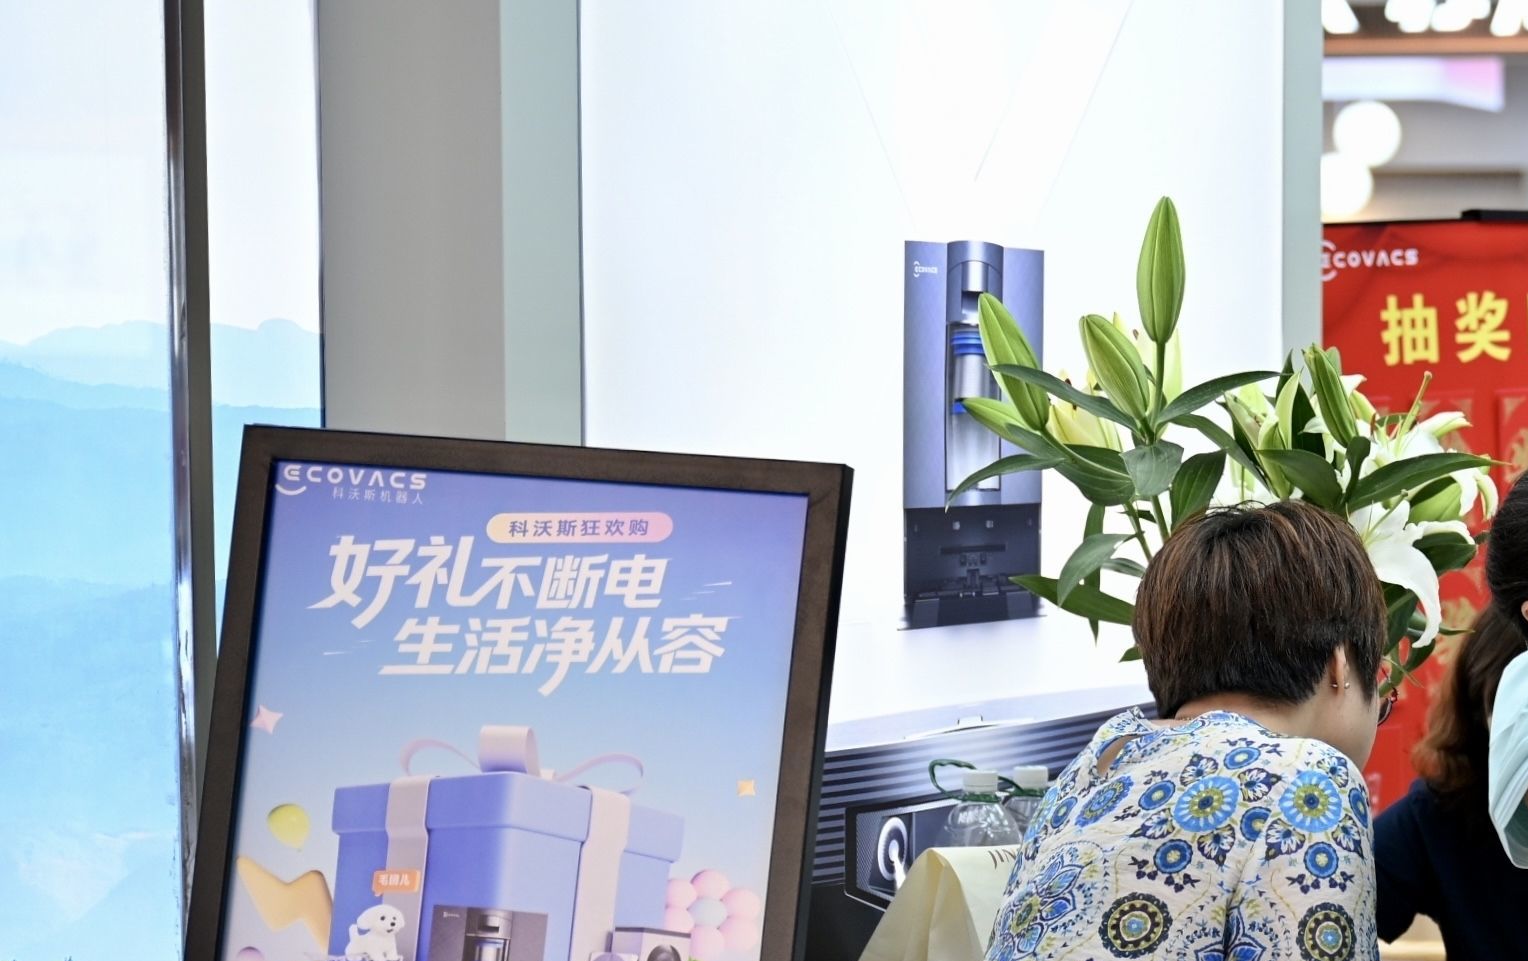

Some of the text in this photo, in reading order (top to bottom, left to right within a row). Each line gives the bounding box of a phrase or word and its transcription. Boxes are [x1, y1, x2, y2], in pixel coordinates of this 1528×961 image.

[282, 464, 427, 491] ECOVACS
[332, 487, 424, 505] 科沃斯机器人
[508, 518, 649, 538] 科沃斯狂欢购
[306, 535, 672, 630] 好礼不断电
[377, 614, 731, 697] 生活净从容
